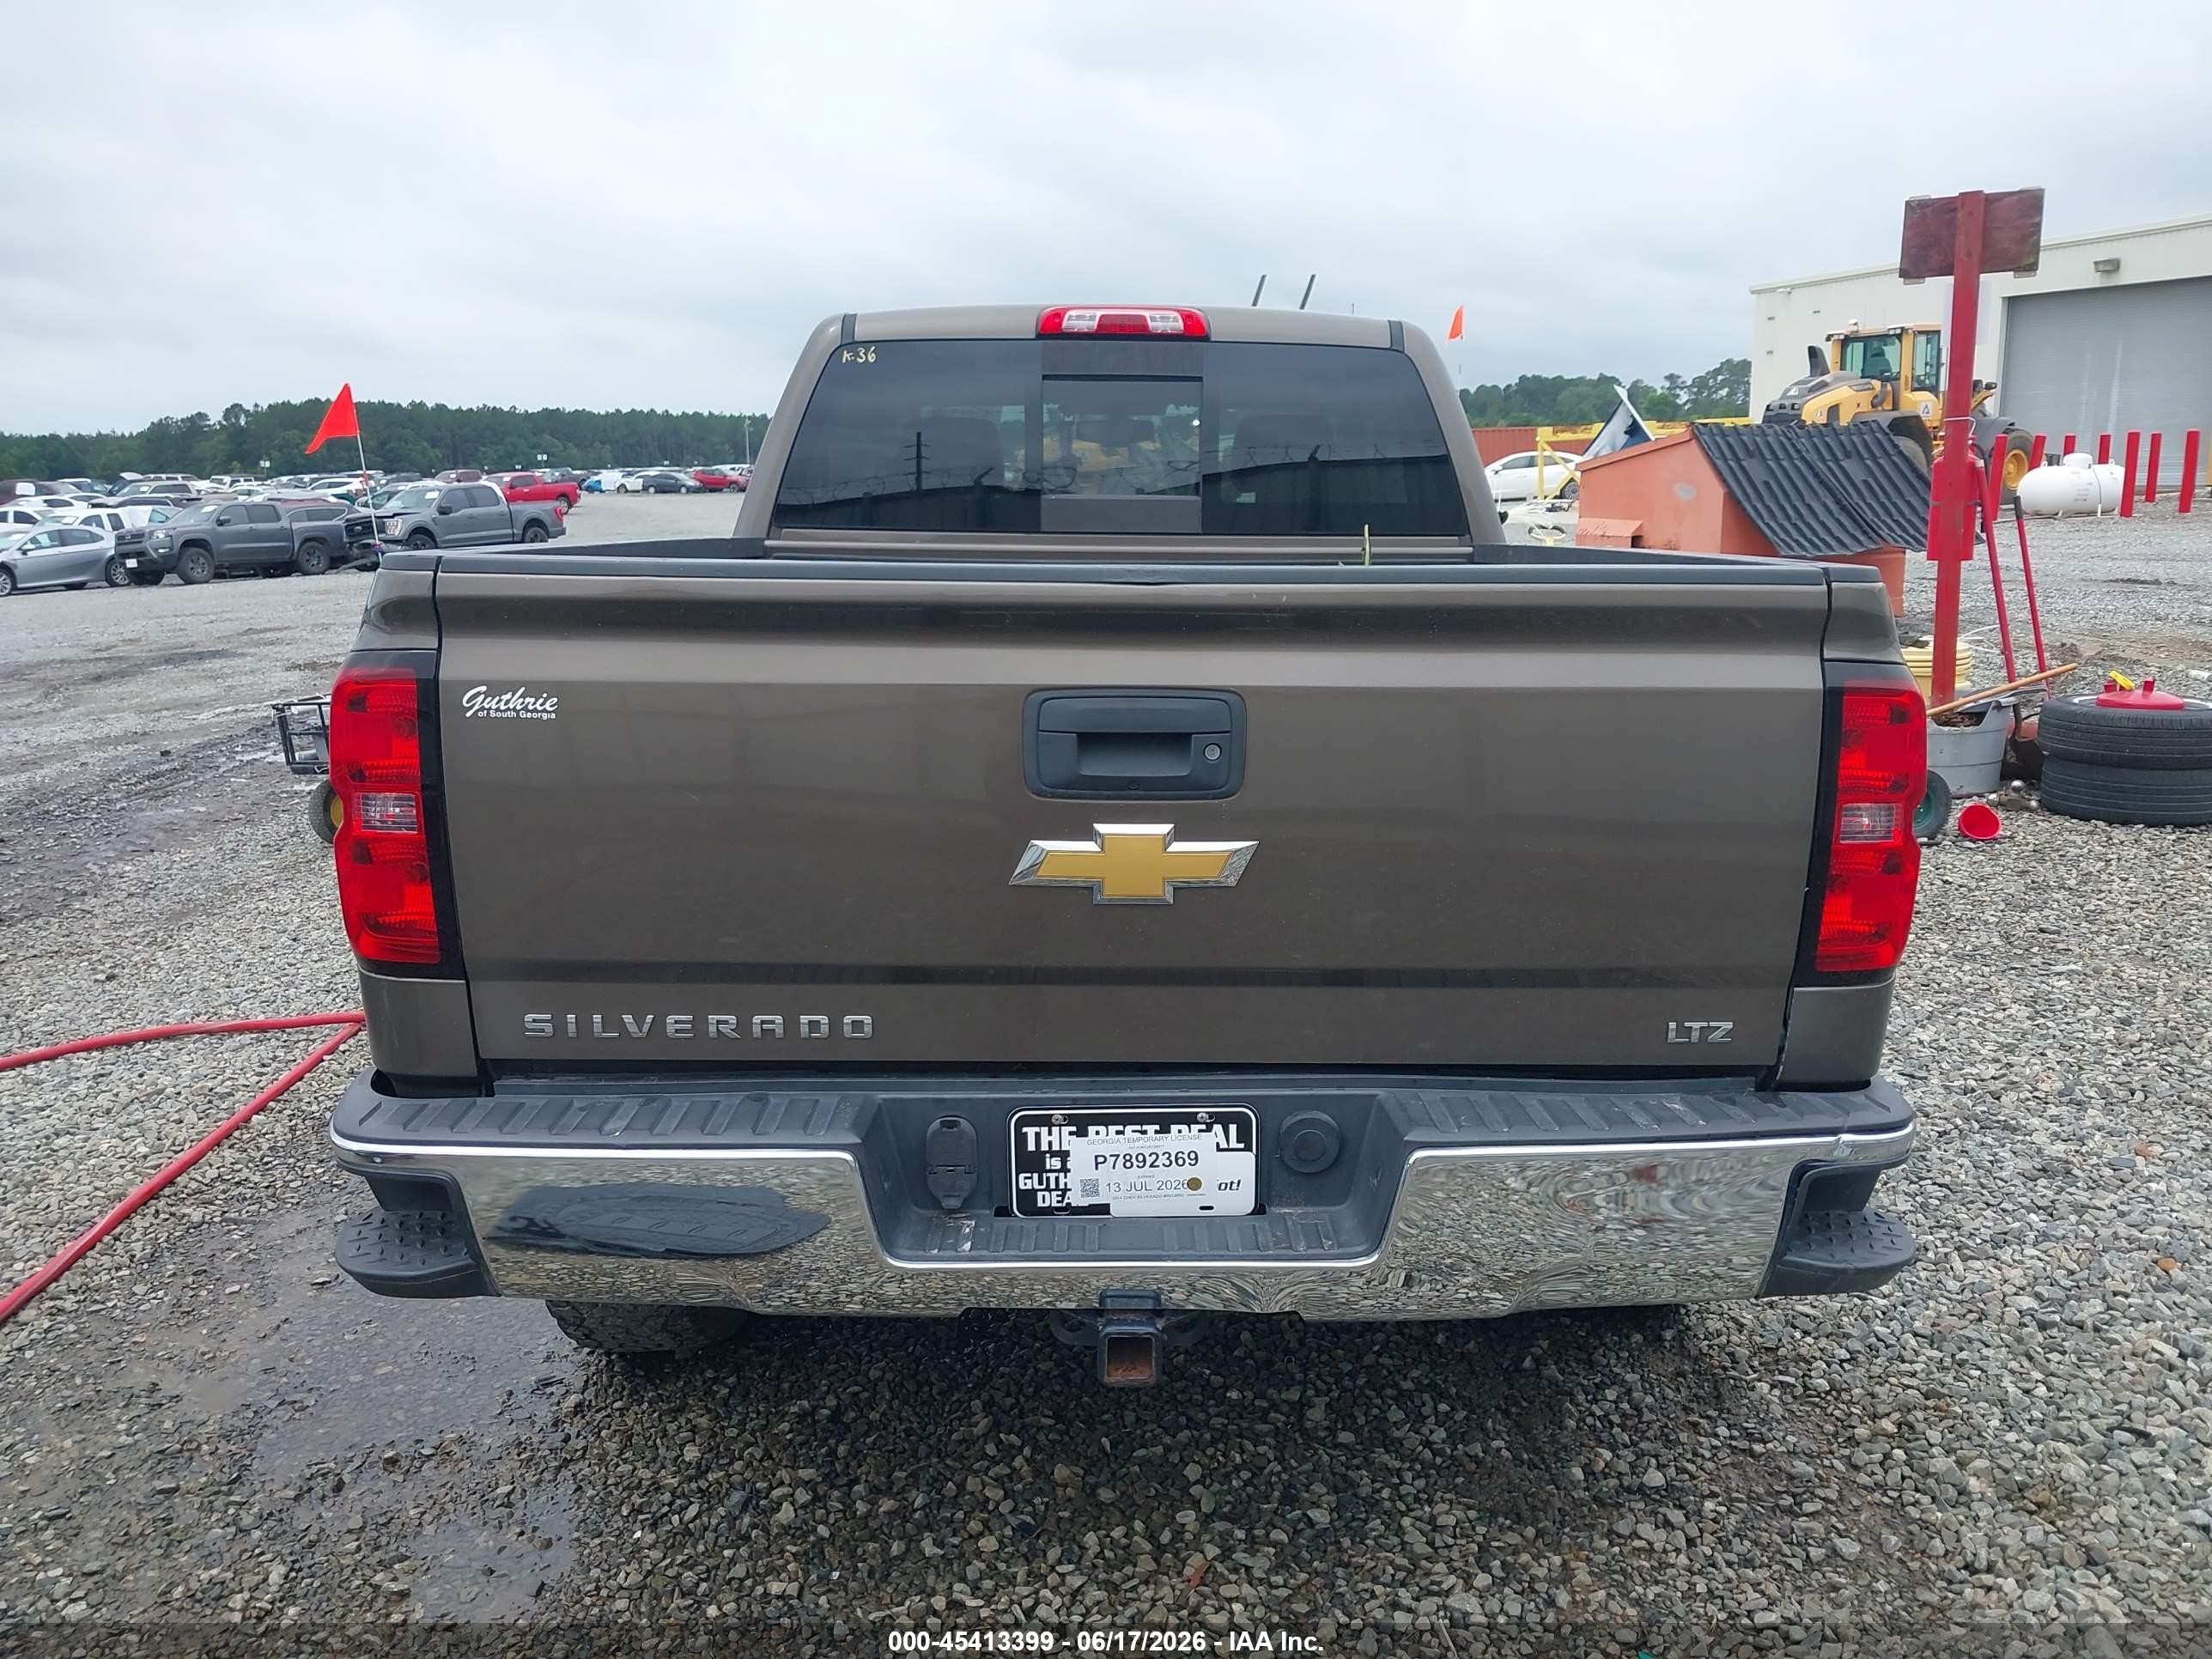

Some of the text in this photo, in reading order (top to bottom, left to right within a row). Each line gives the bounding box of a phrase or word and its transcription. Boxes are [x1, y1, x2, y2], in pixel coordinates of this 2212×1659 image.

[462, 685, 558, 717] Guthrie
[489, 710, 517, 719] South
[520, 711, 556, 720] Georgia
[524, 1013, 874, 1039] SILVERADO
[1667, 1022, 1734, 1042] LTZ
[1021, 1126, 1077, 1152] THE
[1086, 1133, 1203, 1146] GEORGIA TEMPORARY LICENSE
[1045, 1153, 1062, 1170] is
[1094, 1150, 1200, 1170] P7892369
[1106, 1179, 1188, 1194] 13 JUL 2026
